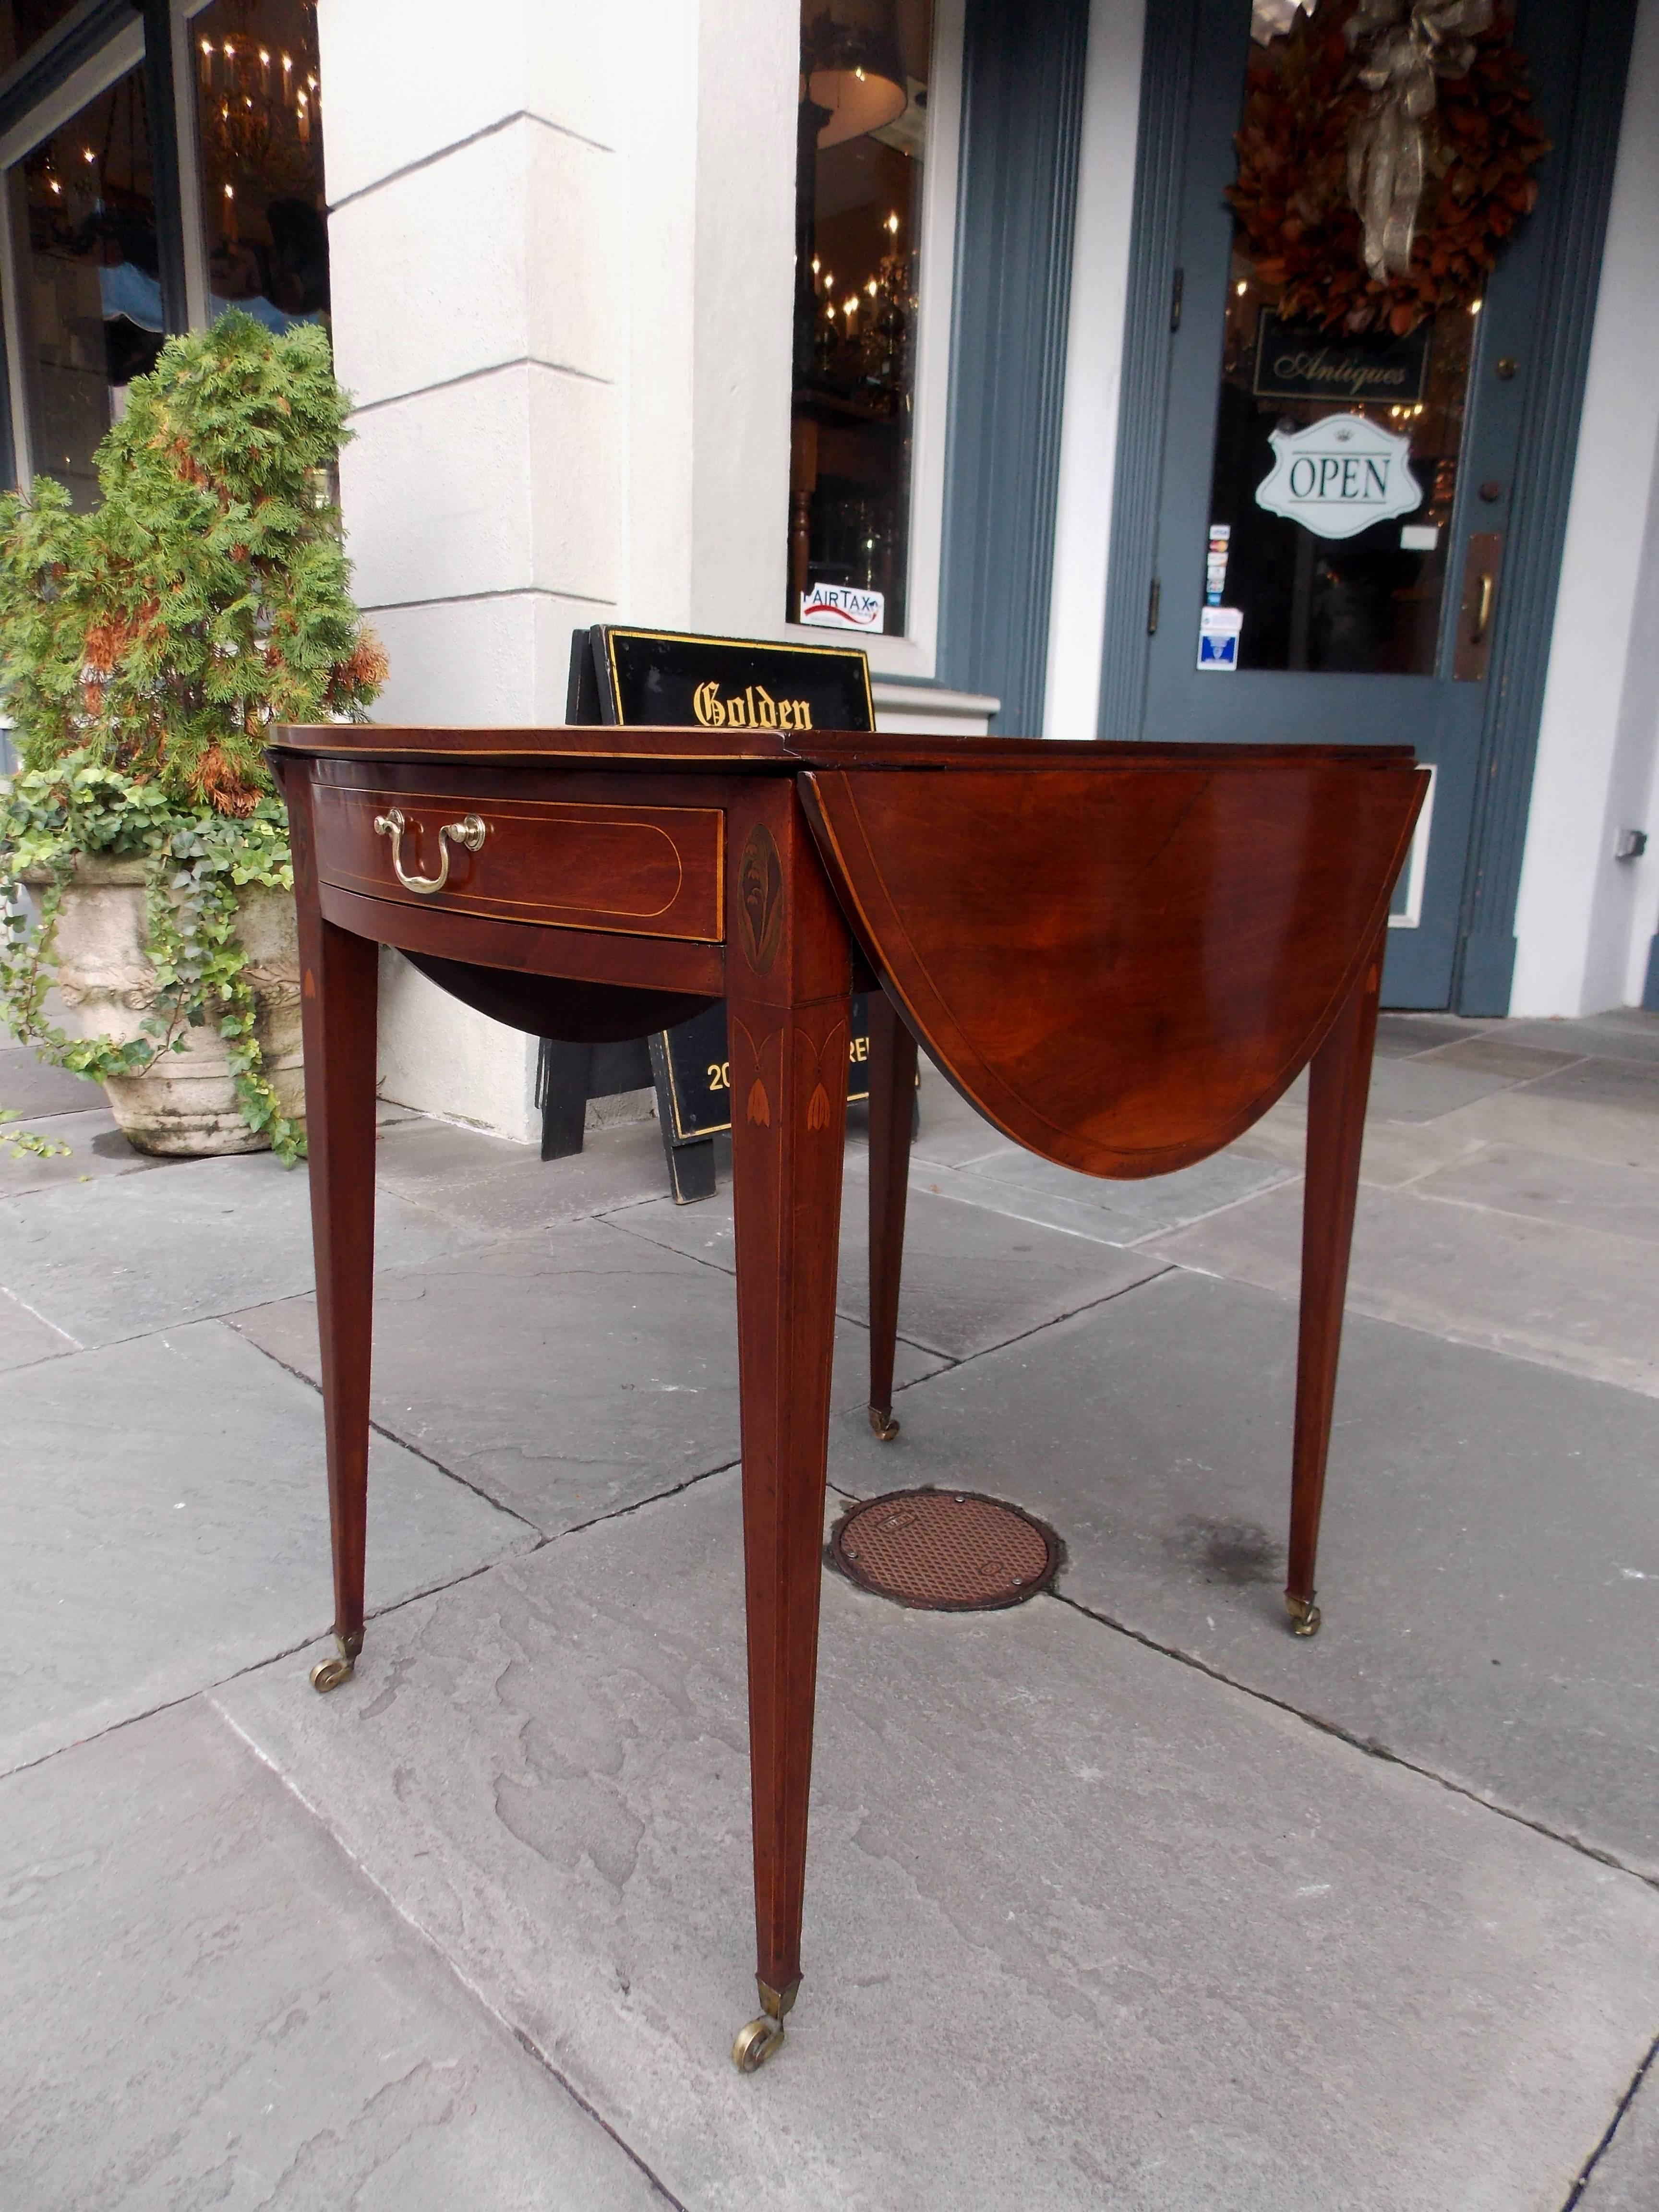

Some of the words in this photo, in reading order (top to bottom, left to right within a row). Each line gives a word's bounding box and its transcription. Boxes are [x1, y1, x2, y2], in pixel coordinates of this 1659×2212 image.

[1274, 346, 1406, 395] Antiques
[1290, 457, 1390, 497] OPEN
[694, 681, 813, 730] Golden
